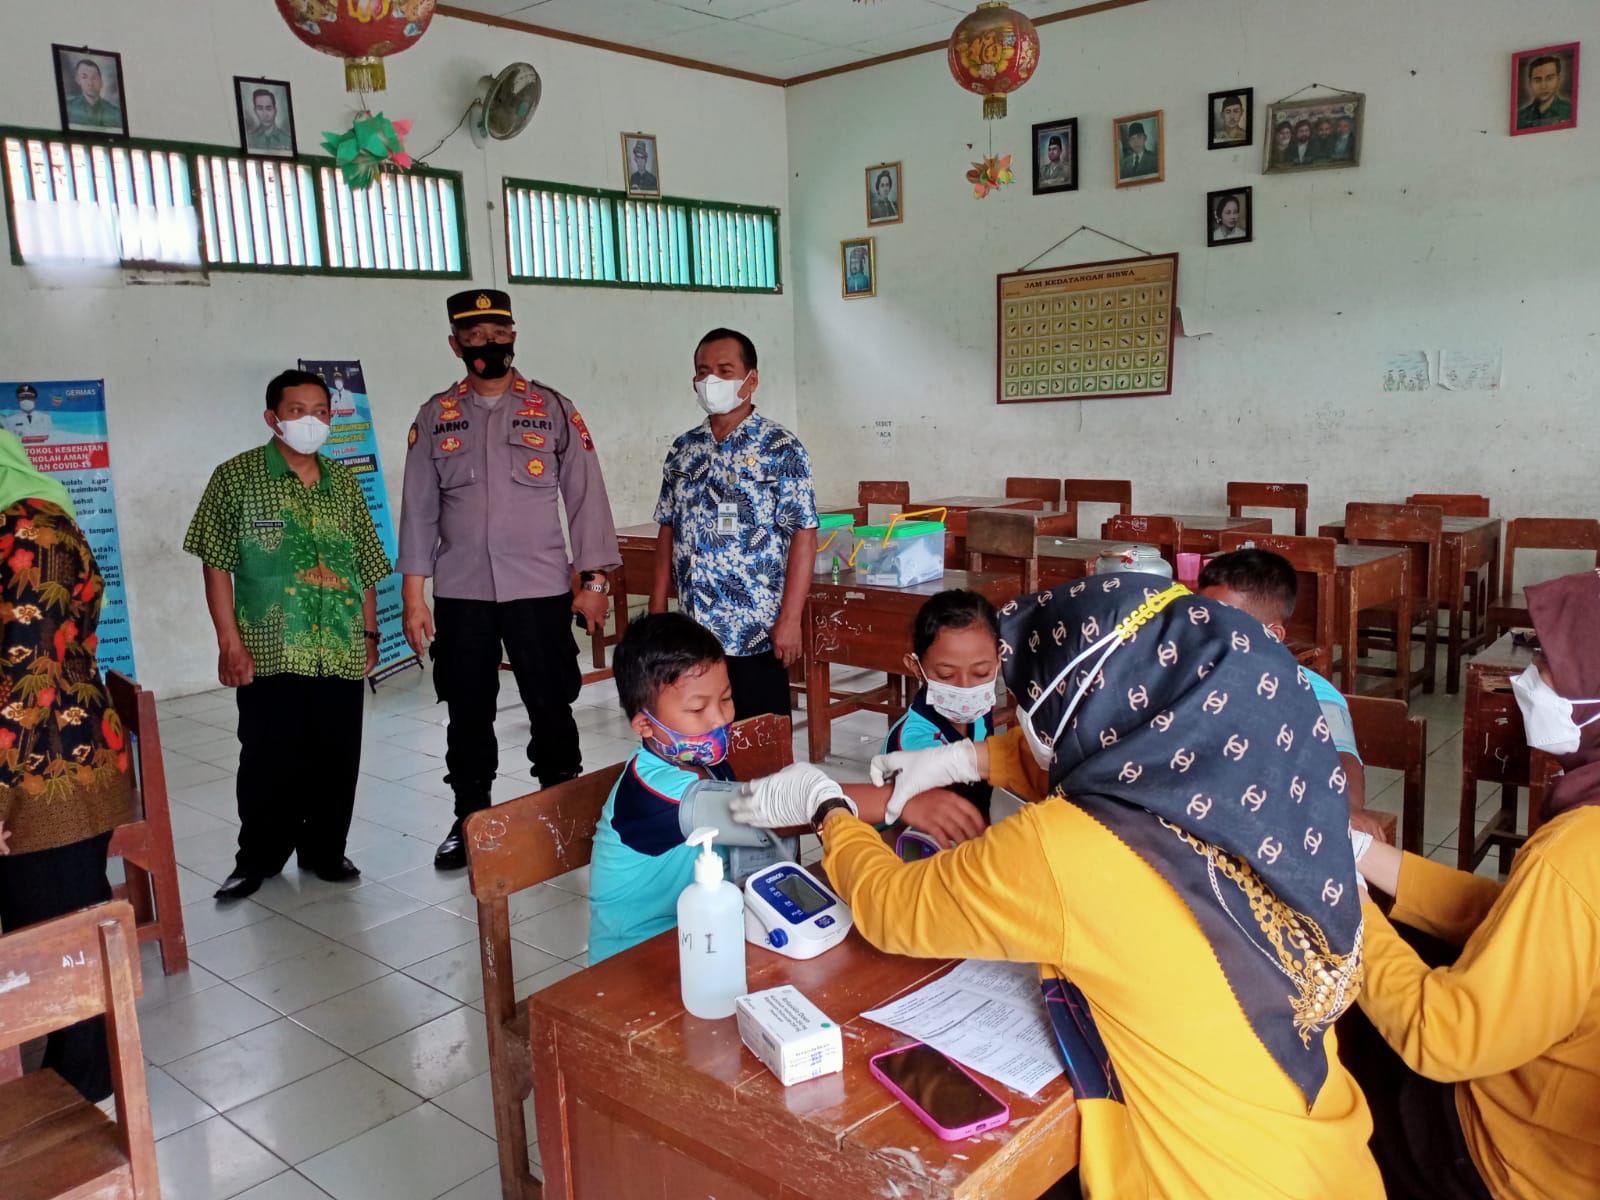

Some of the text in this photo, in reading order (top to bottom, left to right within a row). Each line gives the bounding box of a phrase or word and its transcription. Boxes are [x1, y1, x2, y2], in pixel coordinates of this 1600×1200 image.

[1024, 269, 1135, 289] JAM KEDATANGAN SISWA
[65, 388, 97, 397] GERMAS
[433, 420, 469, 435] JARNO
[512, 419, 552, 431] POLRI
[56, 444, 104, 454] KESEHATAN
[29, 454, 89, 463] KOLAH AMAN
